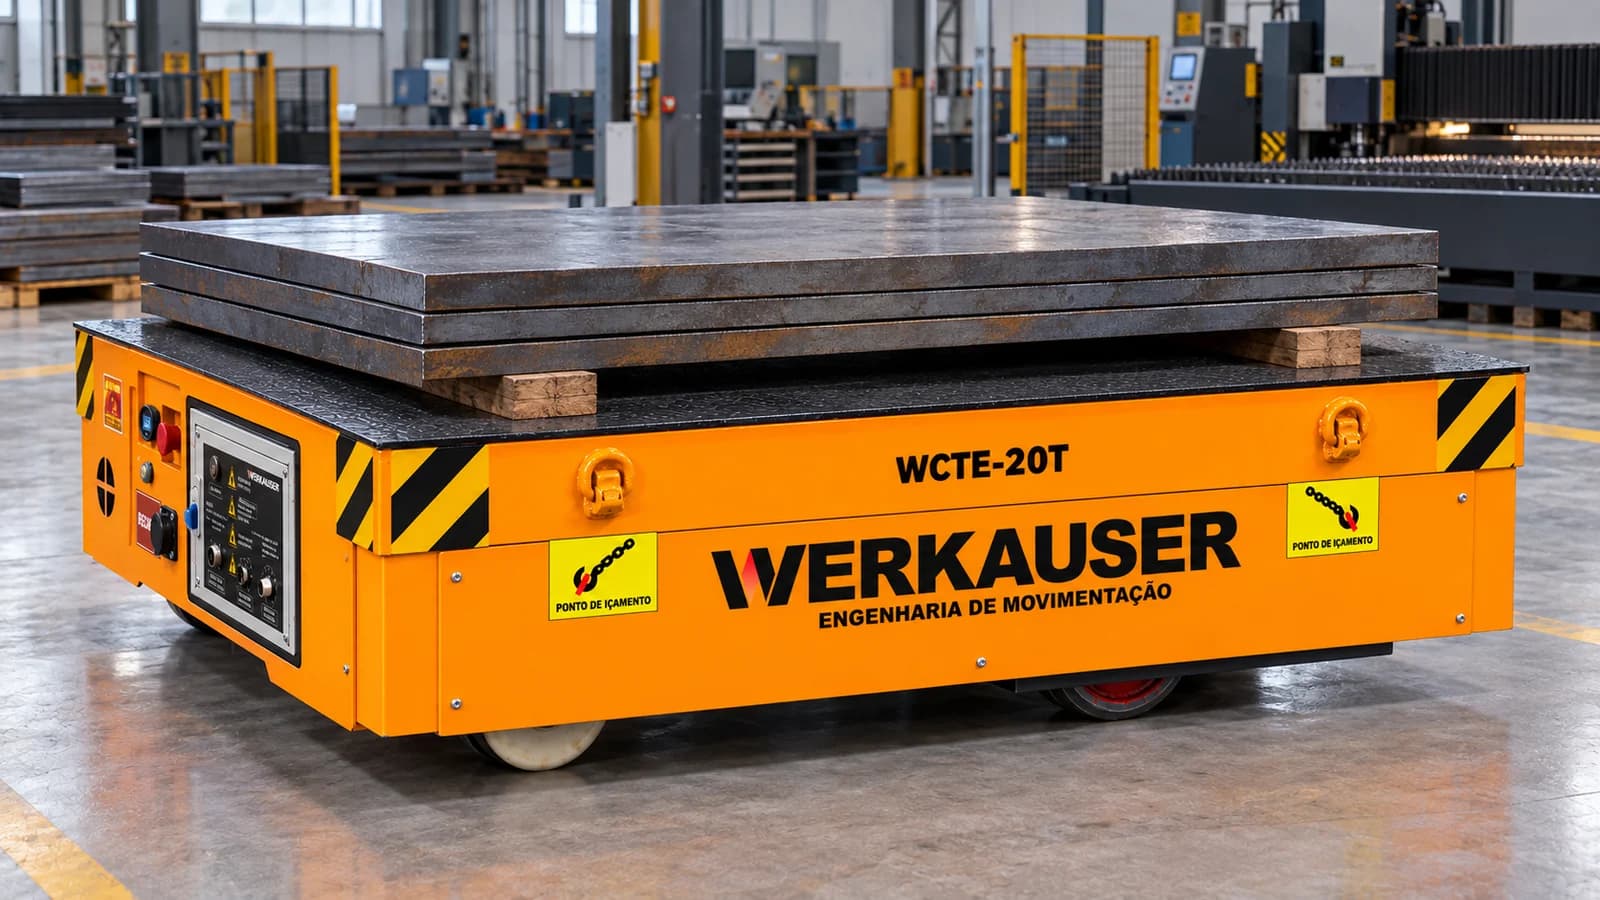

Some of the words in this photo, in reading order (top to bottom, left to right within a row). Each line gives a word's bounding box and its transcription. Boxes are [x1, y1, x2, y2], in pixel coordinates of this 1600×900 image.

[895, 443, 1070, 484] WCTE-20T
[711, 511, 1242, 611] WERKAUSER
[1292, 540, 1320, 551] PONTO
[1321, 539, 1332, 549] DE
[1333, 535, 1374, 549] IÇAMENTO
[555, 601, 588, 613] PONTO
[590, 599, 603, 610] DE
[604, 596, 652, 611] IÇAMENTO
[818, 601, 962, 629] ENGENHARIA
[969, 599, 997, 616] DE
[1003, 580, 1173, 613] MOVIMENTAÇÃO
